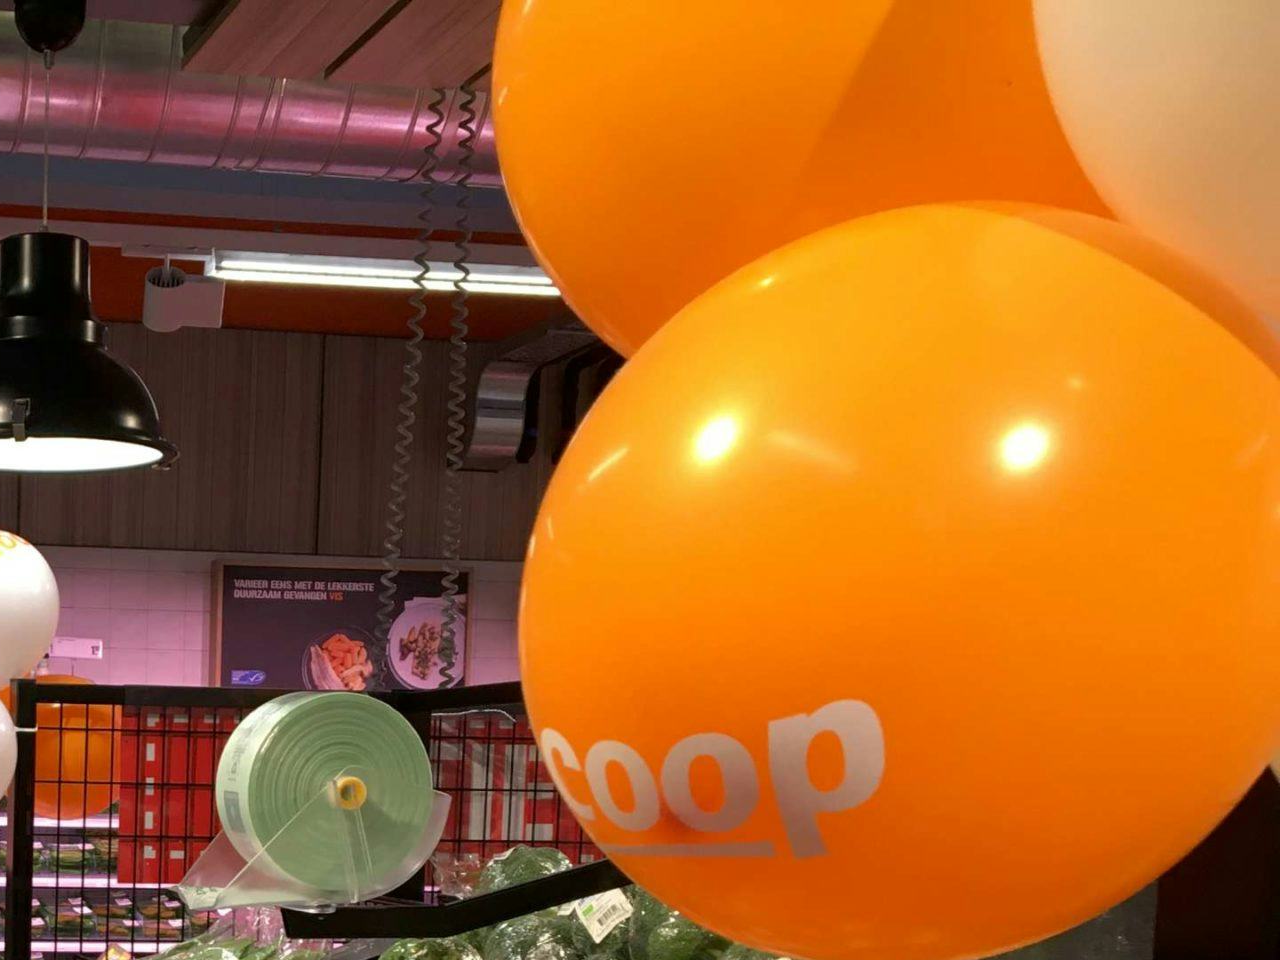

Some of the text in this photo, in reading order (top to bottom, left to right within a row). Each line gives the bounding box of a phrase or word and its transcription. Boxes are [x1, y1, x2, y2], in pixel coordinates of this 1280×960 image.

[233, 578, 375, 592] VARIEER EENS MET DE LEKKERSTE
[233, 589, 344, 601] DUURZAAM GEVANGEN VIS
[540, 698, 886, 860] coop
